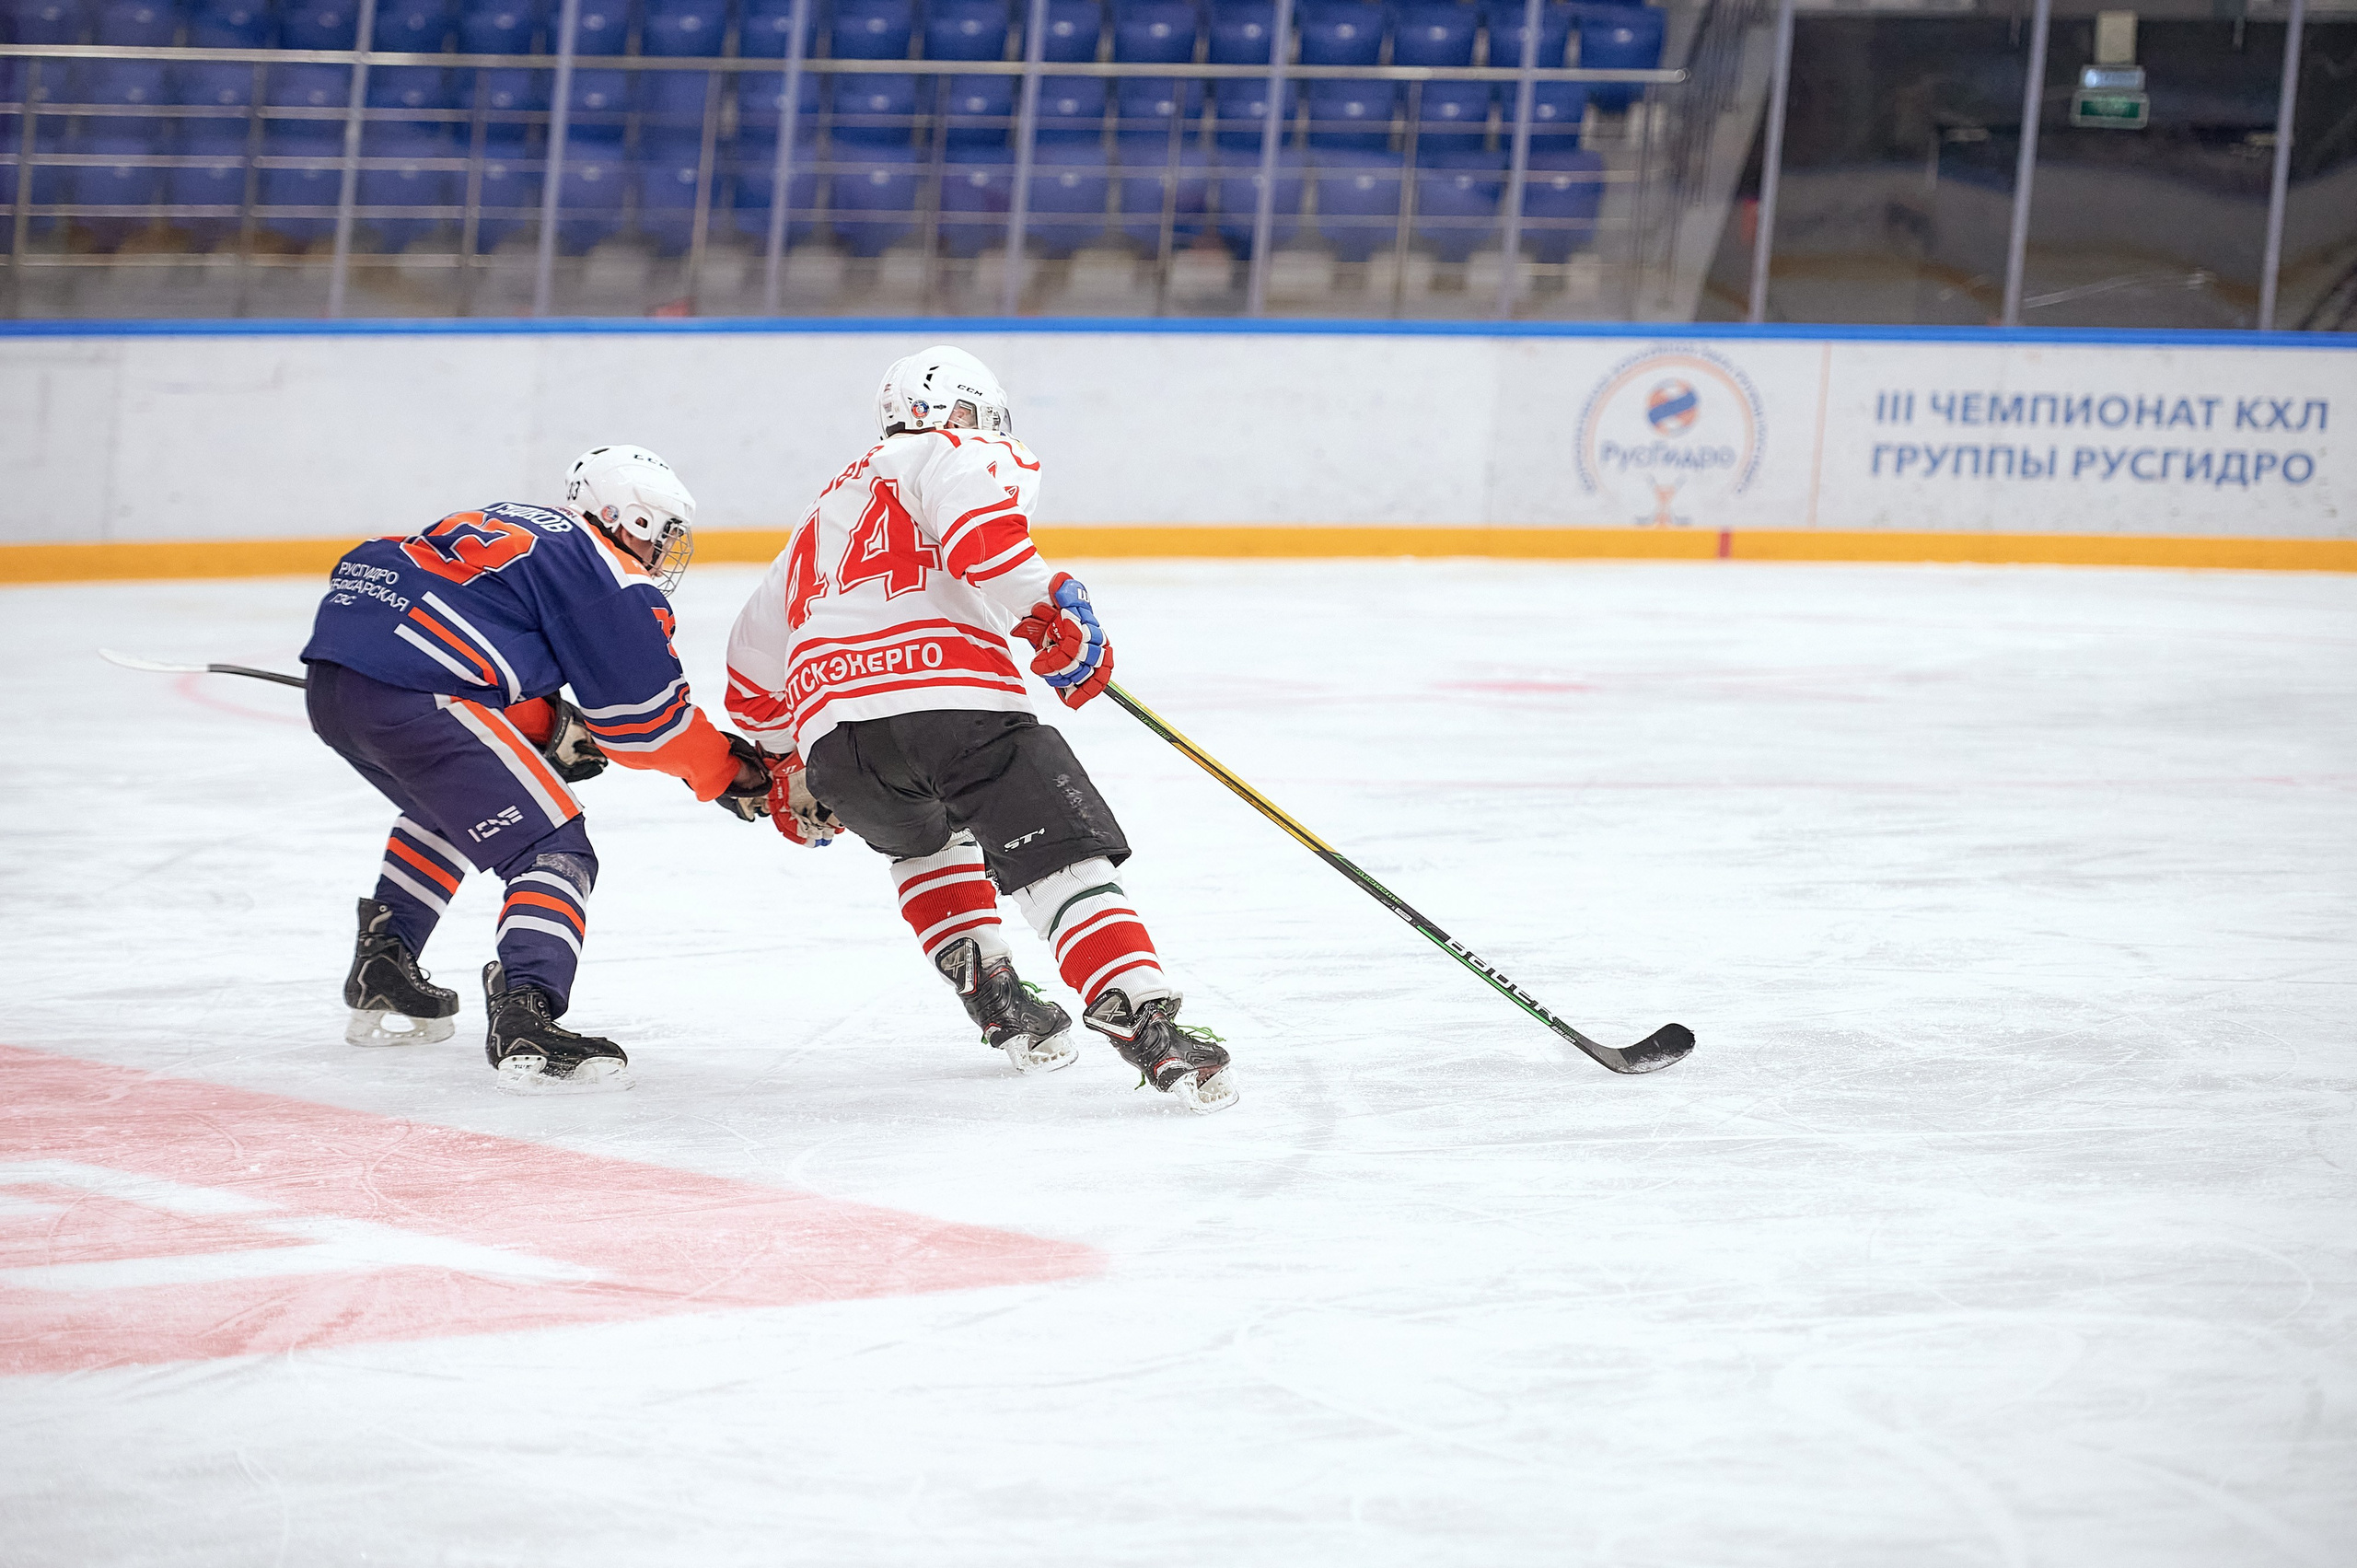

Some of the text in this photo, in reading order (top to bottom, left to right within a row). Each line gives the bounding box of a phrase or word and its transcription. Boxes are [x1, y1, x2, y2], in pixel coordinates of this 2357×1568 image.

[957, 383, 983, 397] CCM
[1930, 391, 2223, 428] ЧЕМПИОНАТ
[2235, 397, 2328, 432] КХЛ
[1872, 444, 2316, 487] ГРУППЫ РУСГИДРО
[338, 562, 400, 585] РУСГИДРО
[785, 474, 944, 633] 44
